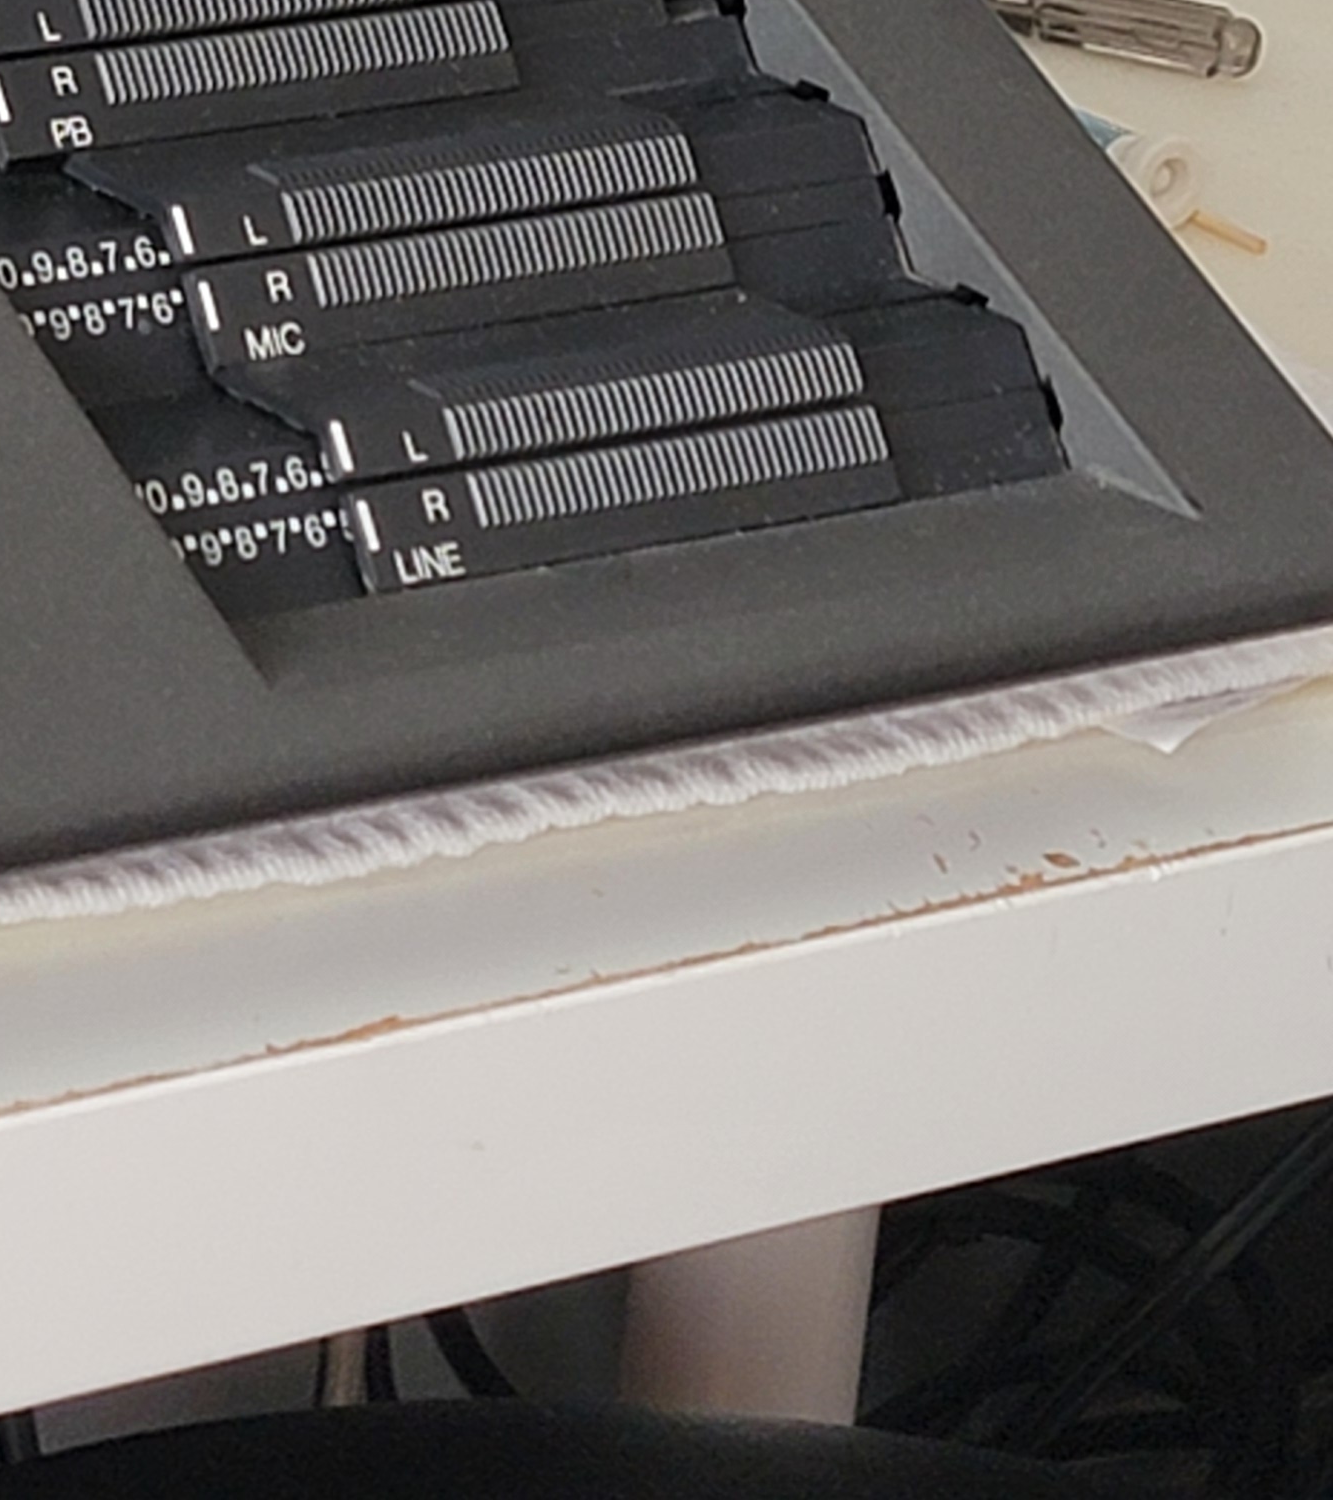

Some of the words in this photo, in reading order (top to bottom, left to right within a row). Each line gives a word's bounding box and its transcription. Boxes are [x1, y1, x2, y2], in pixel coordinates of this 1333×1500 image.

[37, 12, 62, 42] L
[51, 65, 78, 96] R
[50, 115, 93, 149] PB
[243, 215, 268, 246] L
[266, 270, 293, 303] R
[244, 322, 305, 360] MIC
[402, 431, 429, 463] L
[421, 488, 450, 522] R
[393, 541, 466, 584] LINE
